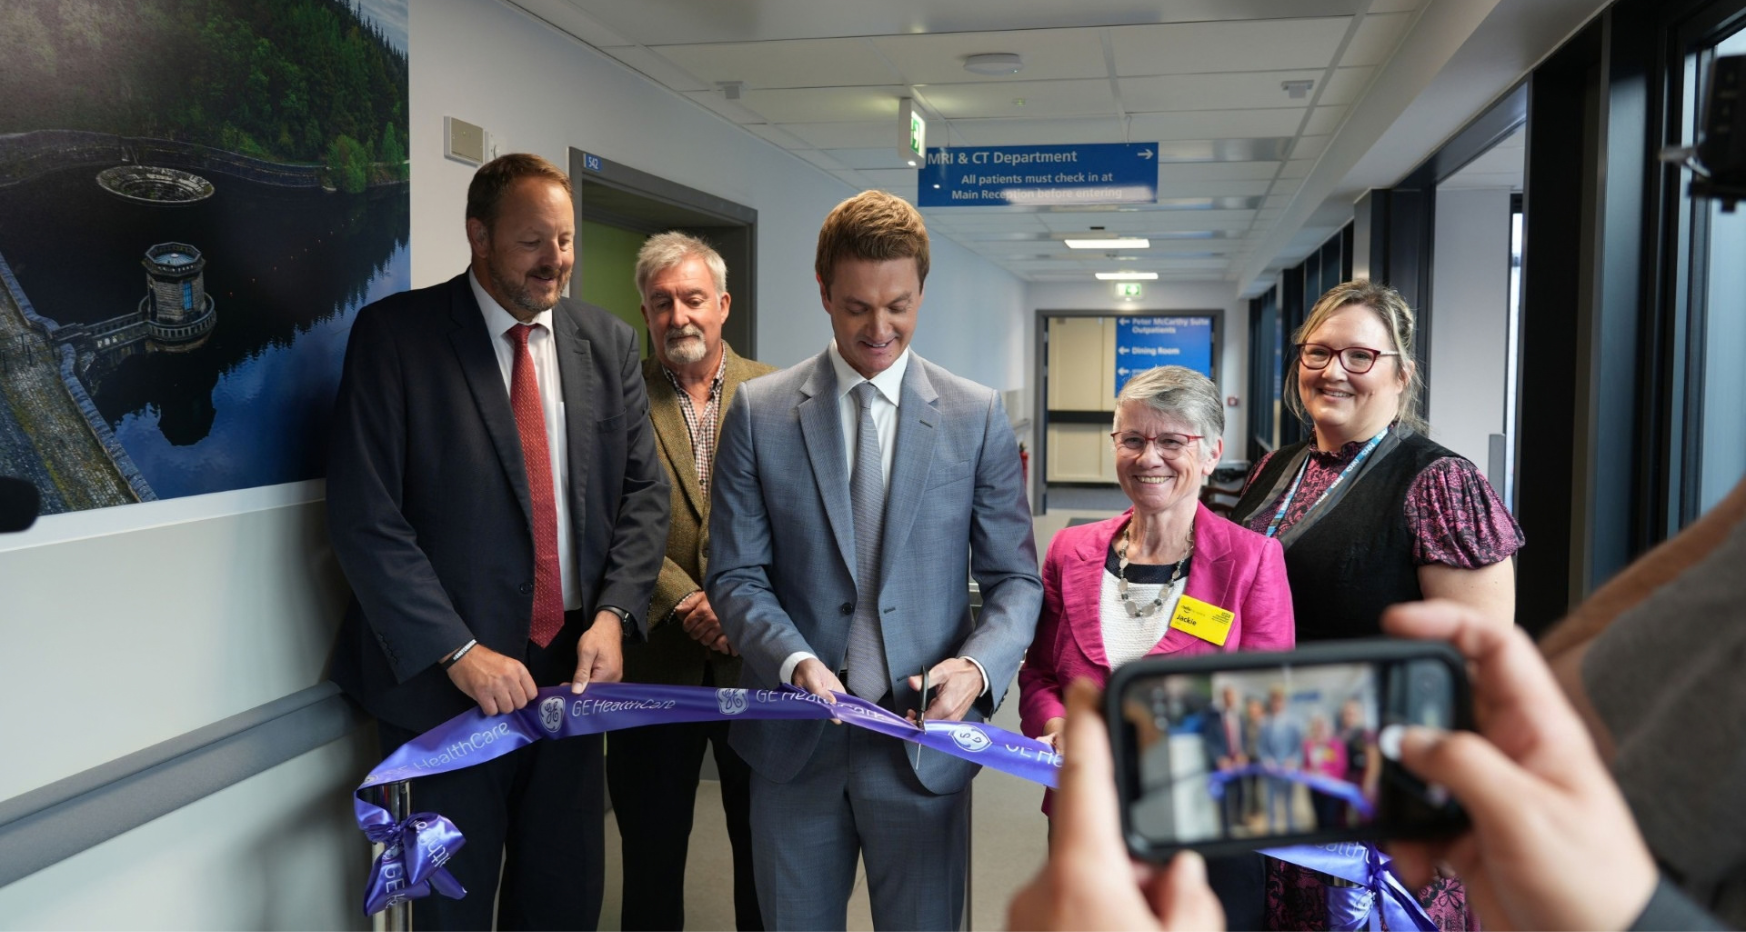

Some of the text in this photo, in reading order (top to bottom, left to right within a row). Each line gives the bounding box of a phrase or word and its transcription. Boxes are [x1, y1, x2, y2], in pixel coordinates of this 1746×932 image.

[588, 156, 599, 170] 542
[927, 151, 1077, 166] MRI & CT Department
[961, 172, 1113, 186] All patients must check in at
[952, 187, 1122, 201] Main Reception before entering
[1132, 317, 1209, 327] Peter McCarthy Suite
[1132, 326, 1176, 334] Outpatients
[1132, 347, 1180, 356] Dining Room
[1176, 614, 1197, 627] Jackie
[572, 700, 592, 717] GE
[593, 699, 676, 714] HealthCare
[414, 722, 510, 770] HealthCare
